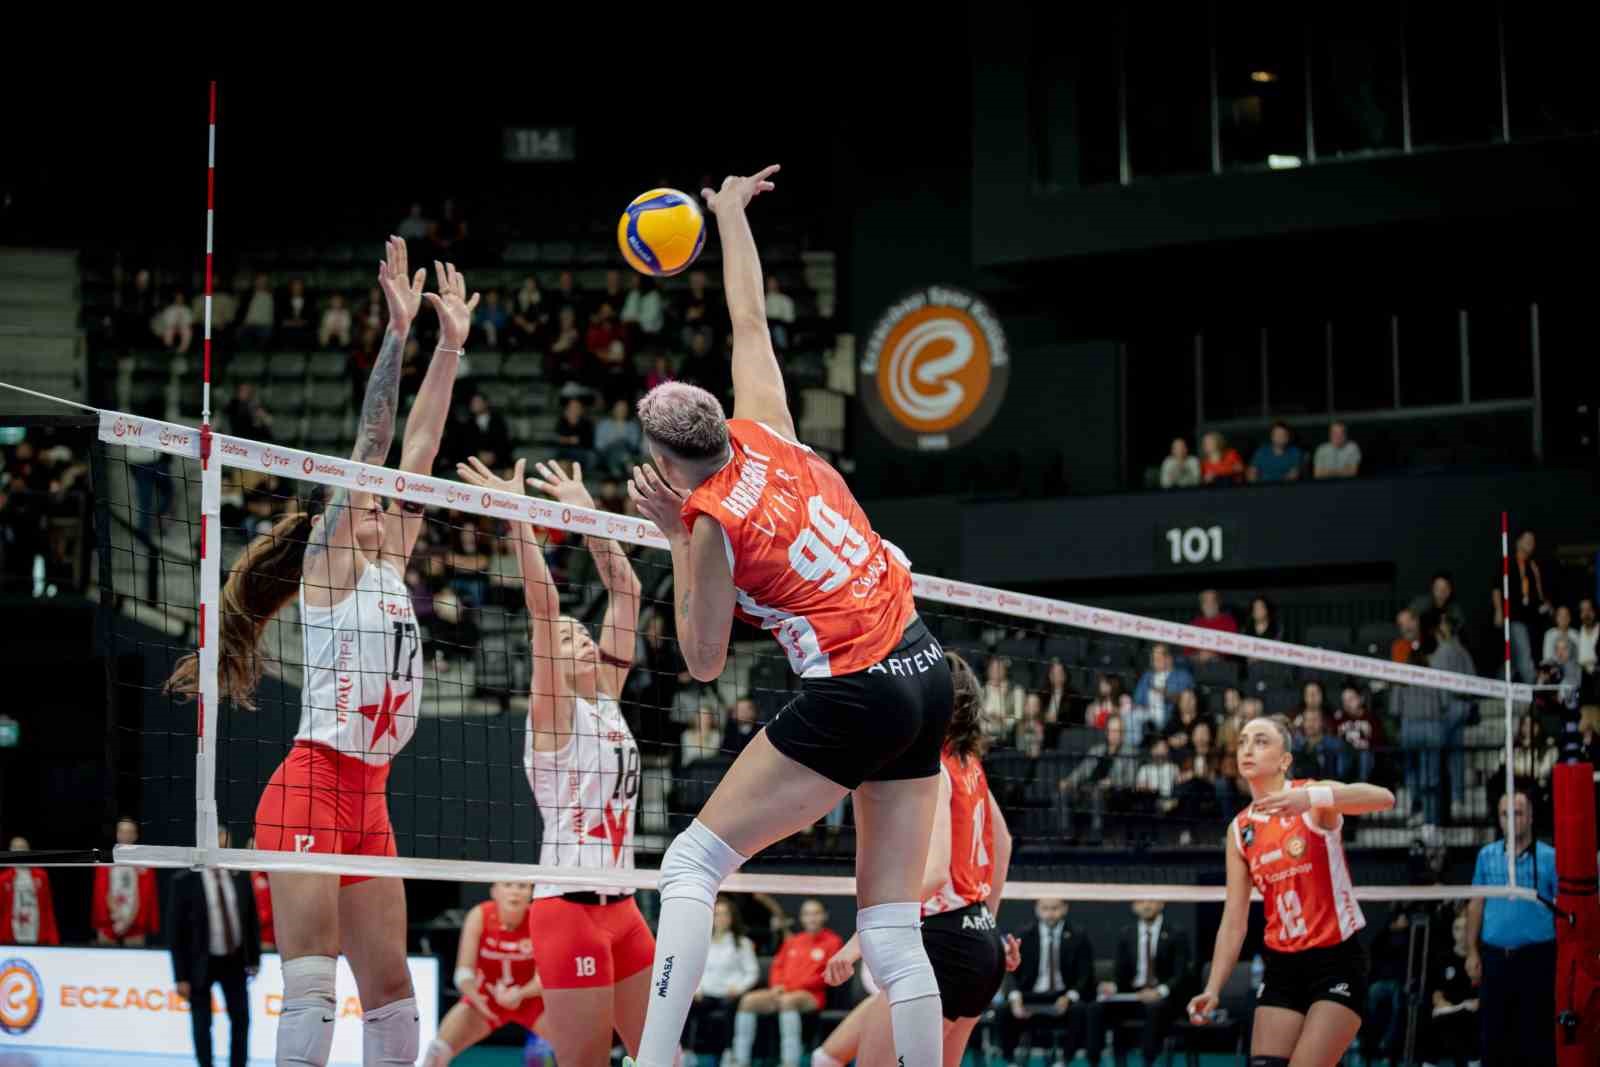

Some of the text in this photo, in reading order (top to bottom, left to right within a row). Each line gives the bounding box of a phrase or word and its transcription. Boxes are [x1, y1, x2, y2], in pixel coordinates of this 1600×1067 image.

[516, 130, 560, 154] 114
[221, 442, 248, 457] odafone
[315, 465, 345, 477] vodafone
[788, 494, 870, 593] 99
[1166, 526, 1223, 565] 101
[392, 620, 418, 682] 17
[868, 639, 944, 678] ARTEM
[612, 747, 639, 800] 18
[1277, 889, 1309, 941] 12
[575, 955, 597, 977] 18
[658, 954, 675, 998] MIKASA
[60, 983, 223, 1014] ECZACIB
